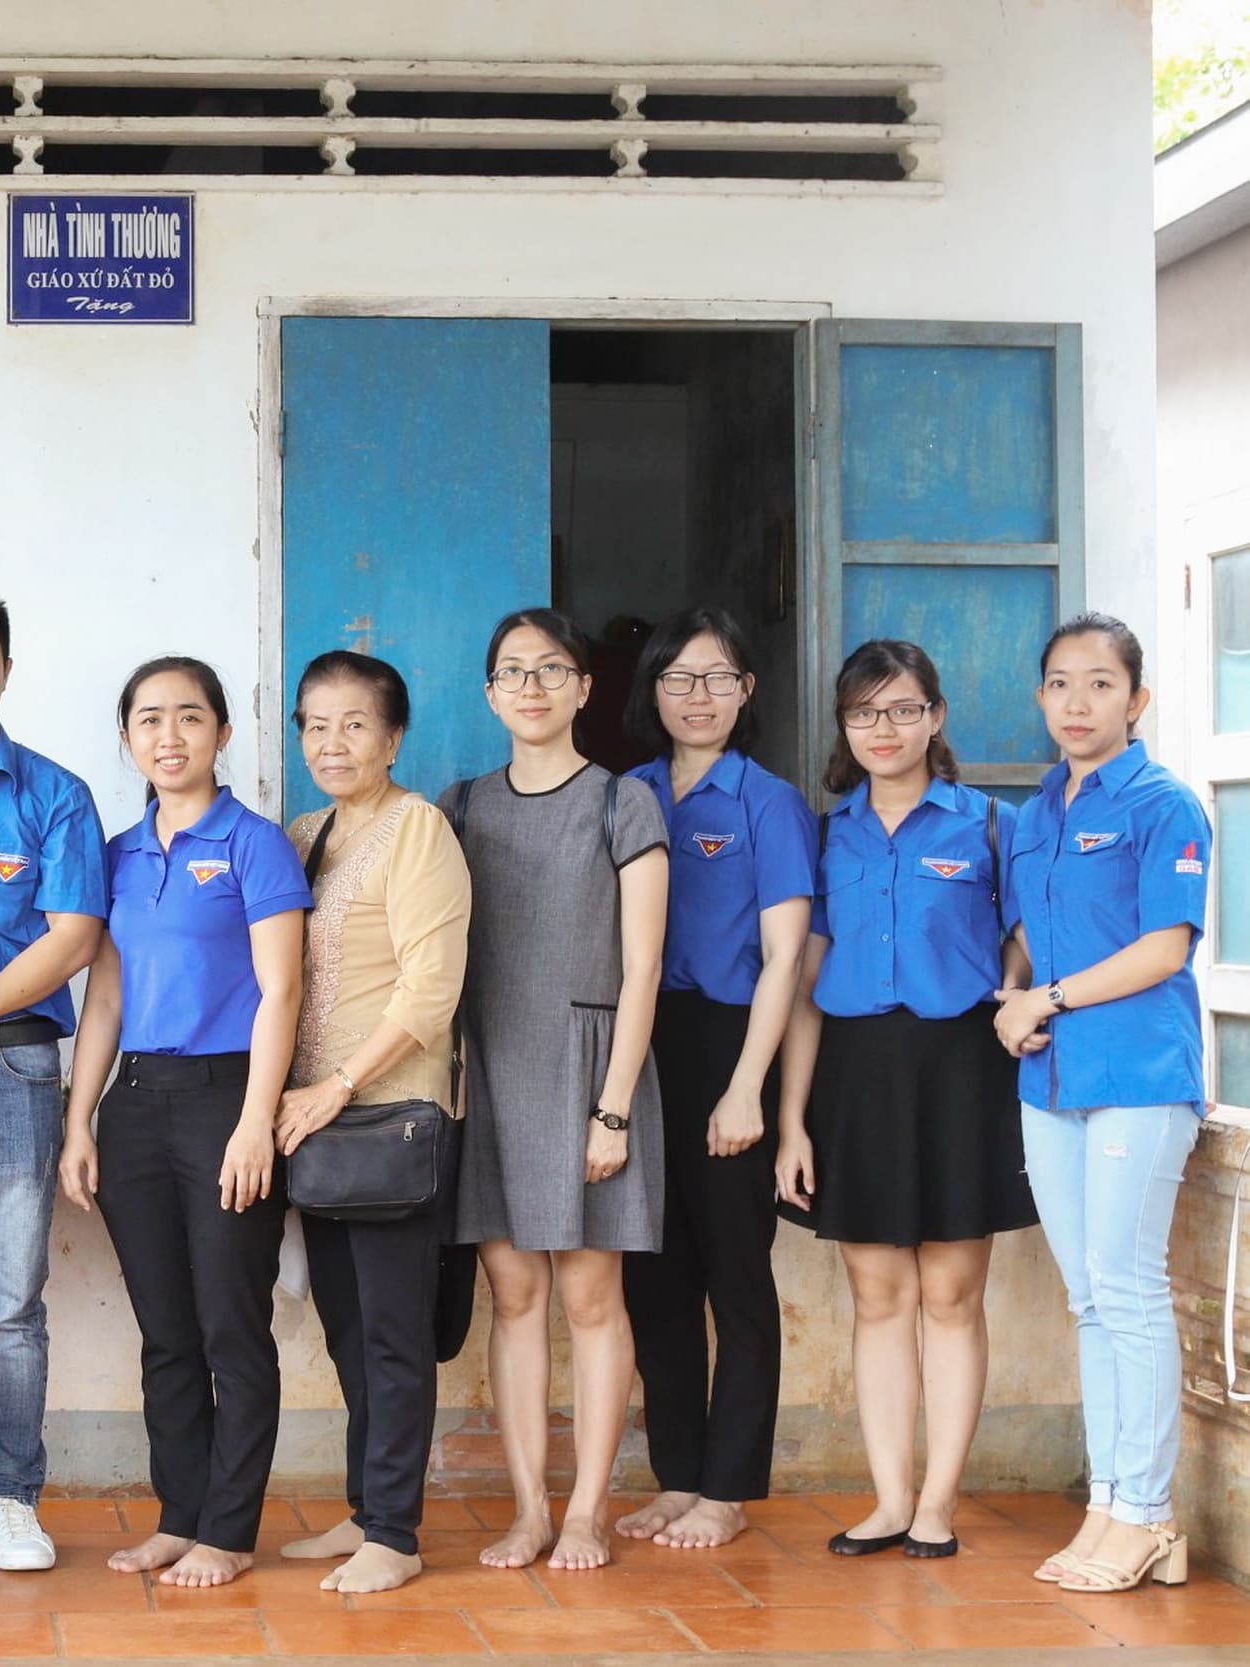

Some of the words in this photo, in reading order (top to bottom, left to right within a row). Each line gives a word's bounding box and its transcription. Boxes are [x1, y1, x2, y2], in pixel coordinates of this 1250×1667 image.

[23, 201, 59, 258] NHÀ
[65, 201, 105, 258] TÌNH
[111, 205, 181, 259] THƯƠNG
[27, 268, 73, 289] GIÁO
[77, 268, 104, 289] XỨ
[107, 265, 145, 288] ĐẤT
[149, 266, 175, 289] ĐỎ
[66, 296, 135, 313] Tặng
